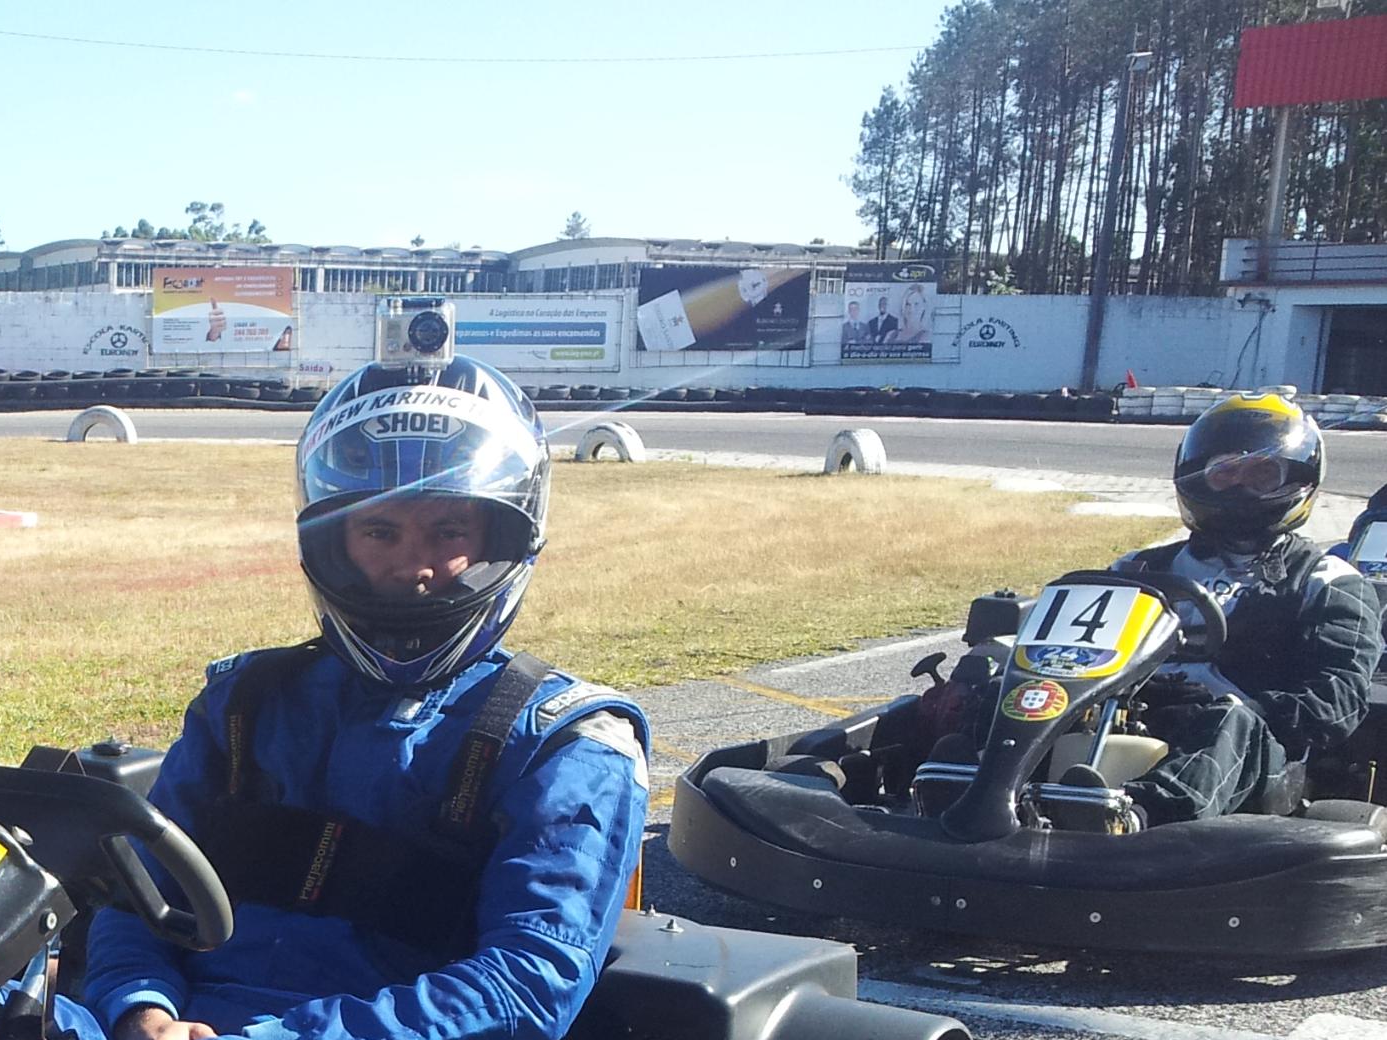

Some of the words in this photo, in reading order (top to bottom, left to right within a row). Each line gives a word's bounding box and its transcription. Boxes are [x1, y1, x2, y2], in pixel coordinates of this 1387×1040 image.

[325, 400, 368, 434] NEW
[376, 412, 449, 434] SHOEI
[1034, 589, 1115, 644] 14
